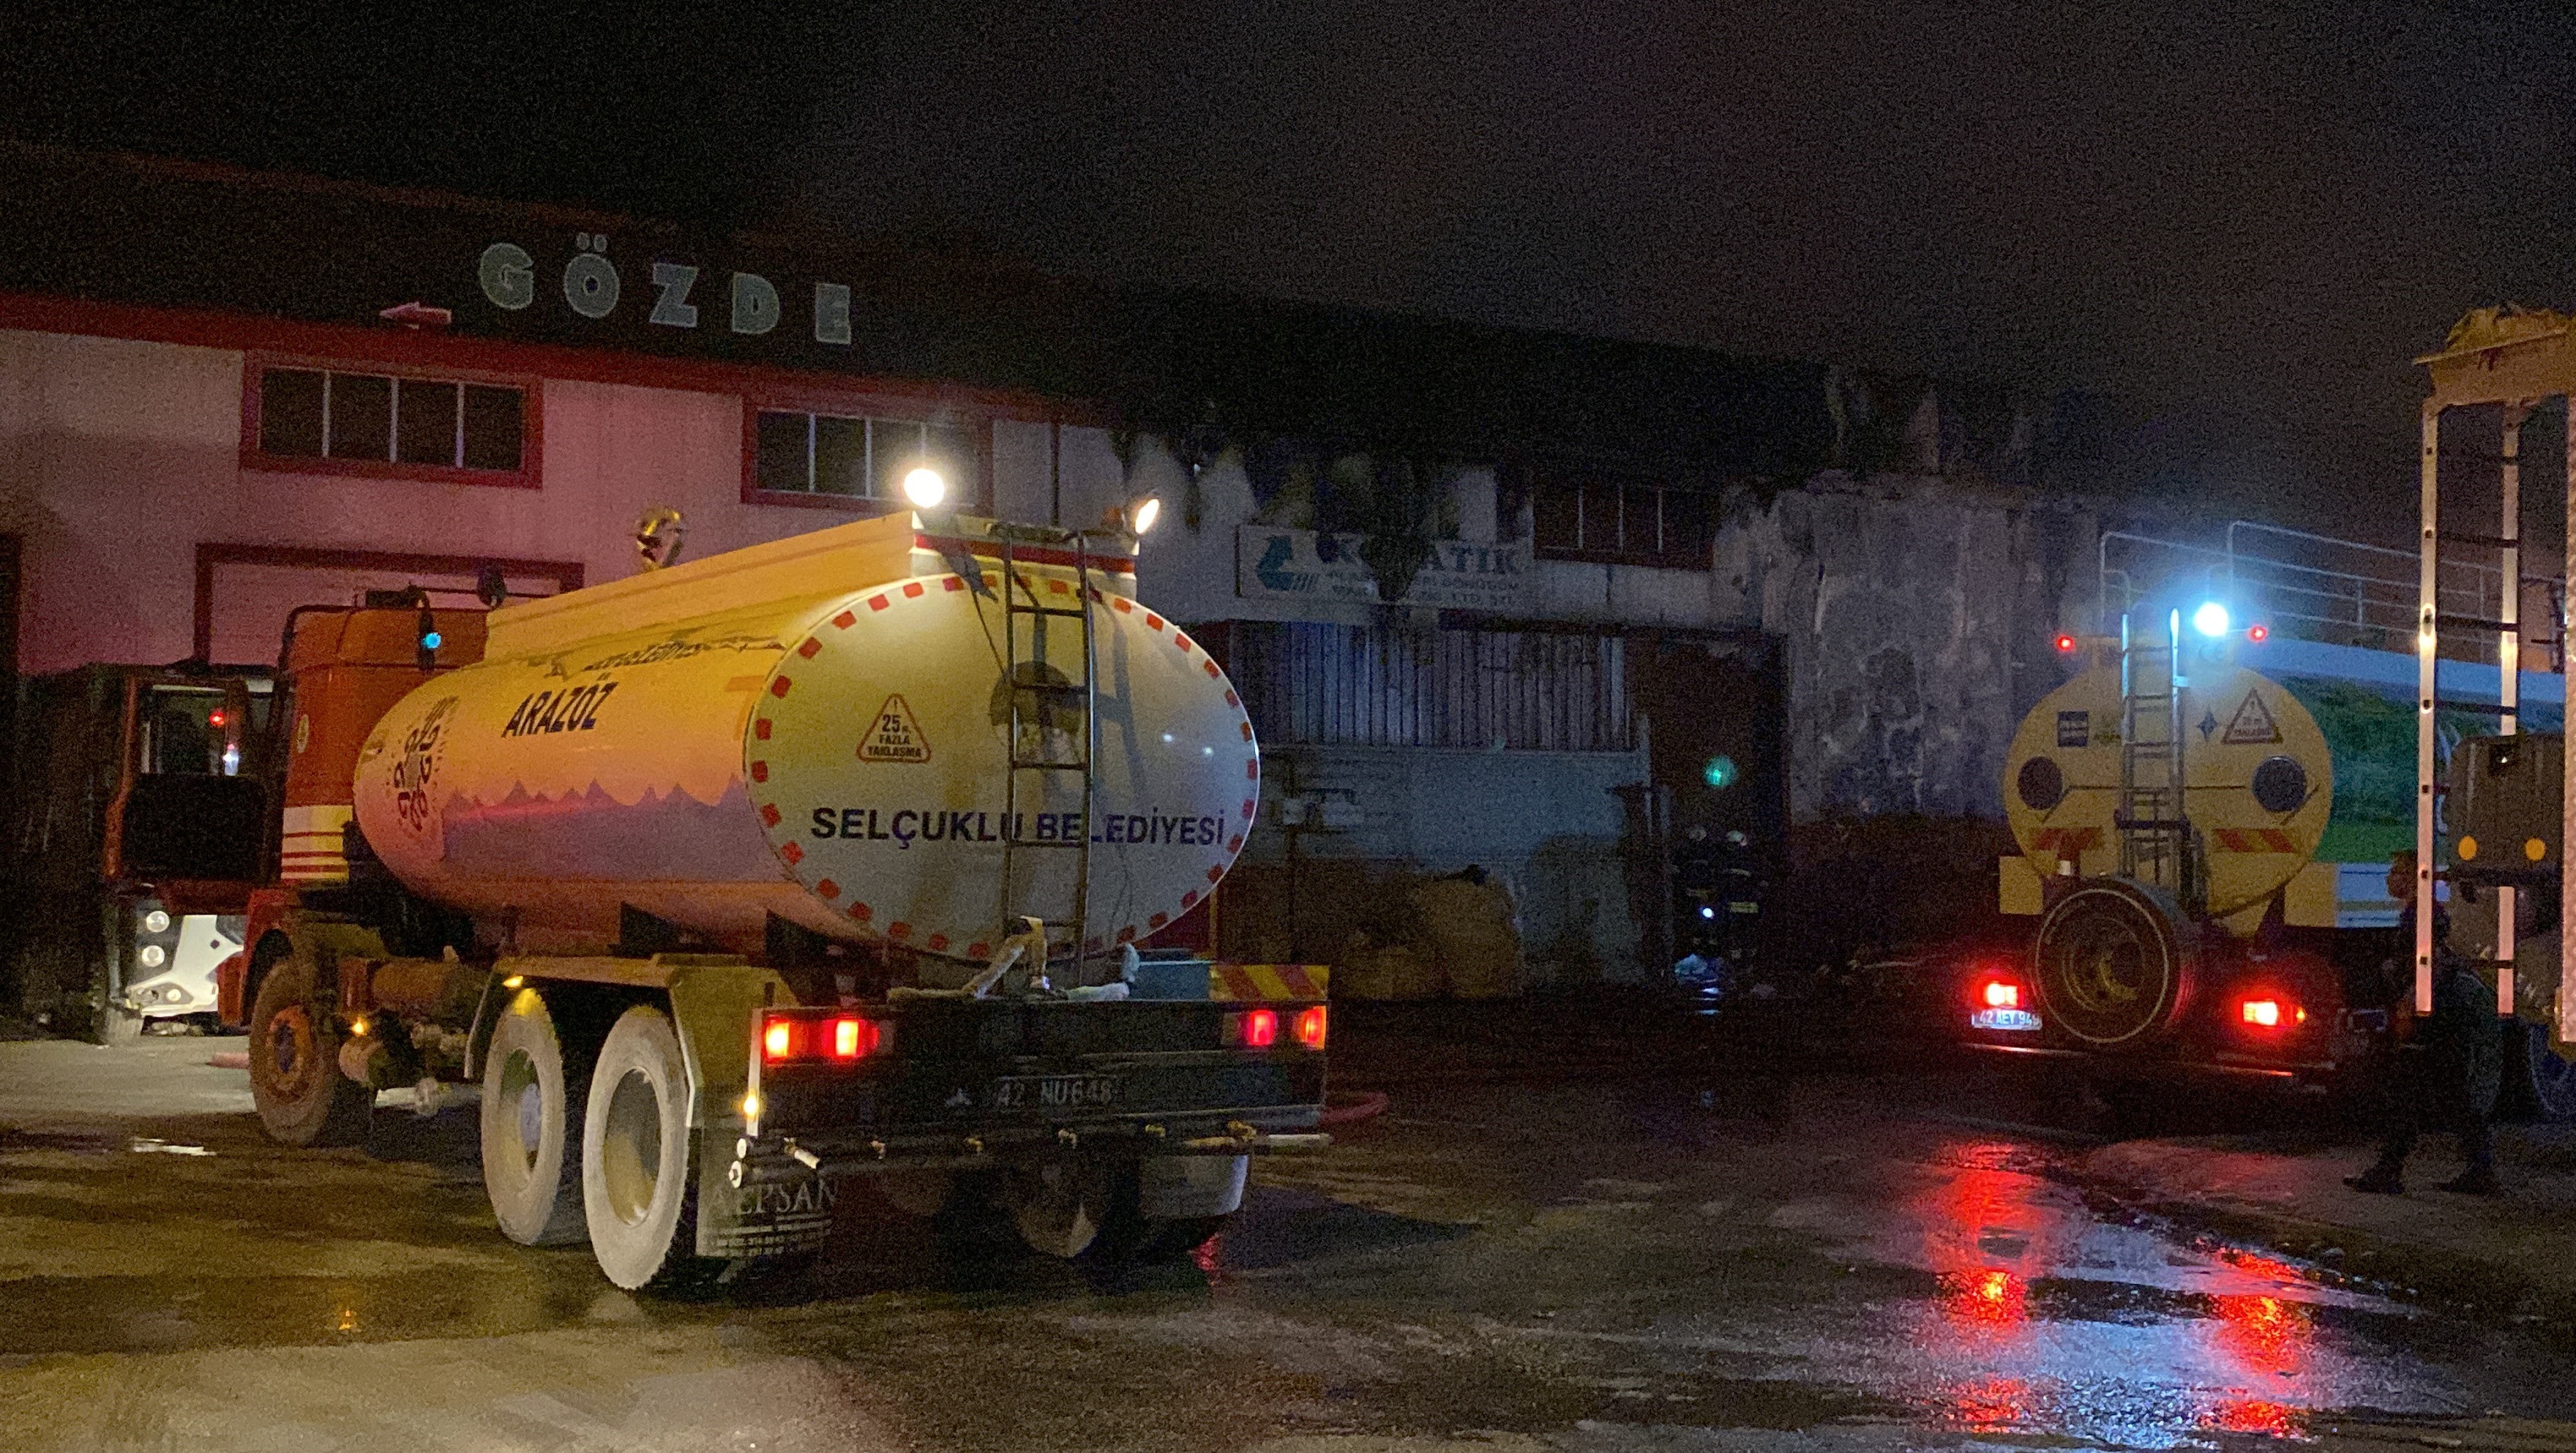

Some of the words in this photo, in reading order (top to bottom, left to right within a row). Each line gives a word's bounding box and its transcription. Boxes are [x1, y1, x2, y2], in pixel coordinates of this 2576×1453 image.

[478, 232, 852, 345] GÖZDE
[501, 671, 619, 739] ARAZÖZ
[881, 713, 902, 733] 25
[878, 734, 911, 746] FAZLA
[810, 807, 1024, 850] SELÇUKLU
[1979, 1010, 1993, 1025] 42
[994, 1081, 1026, 1107] 42
